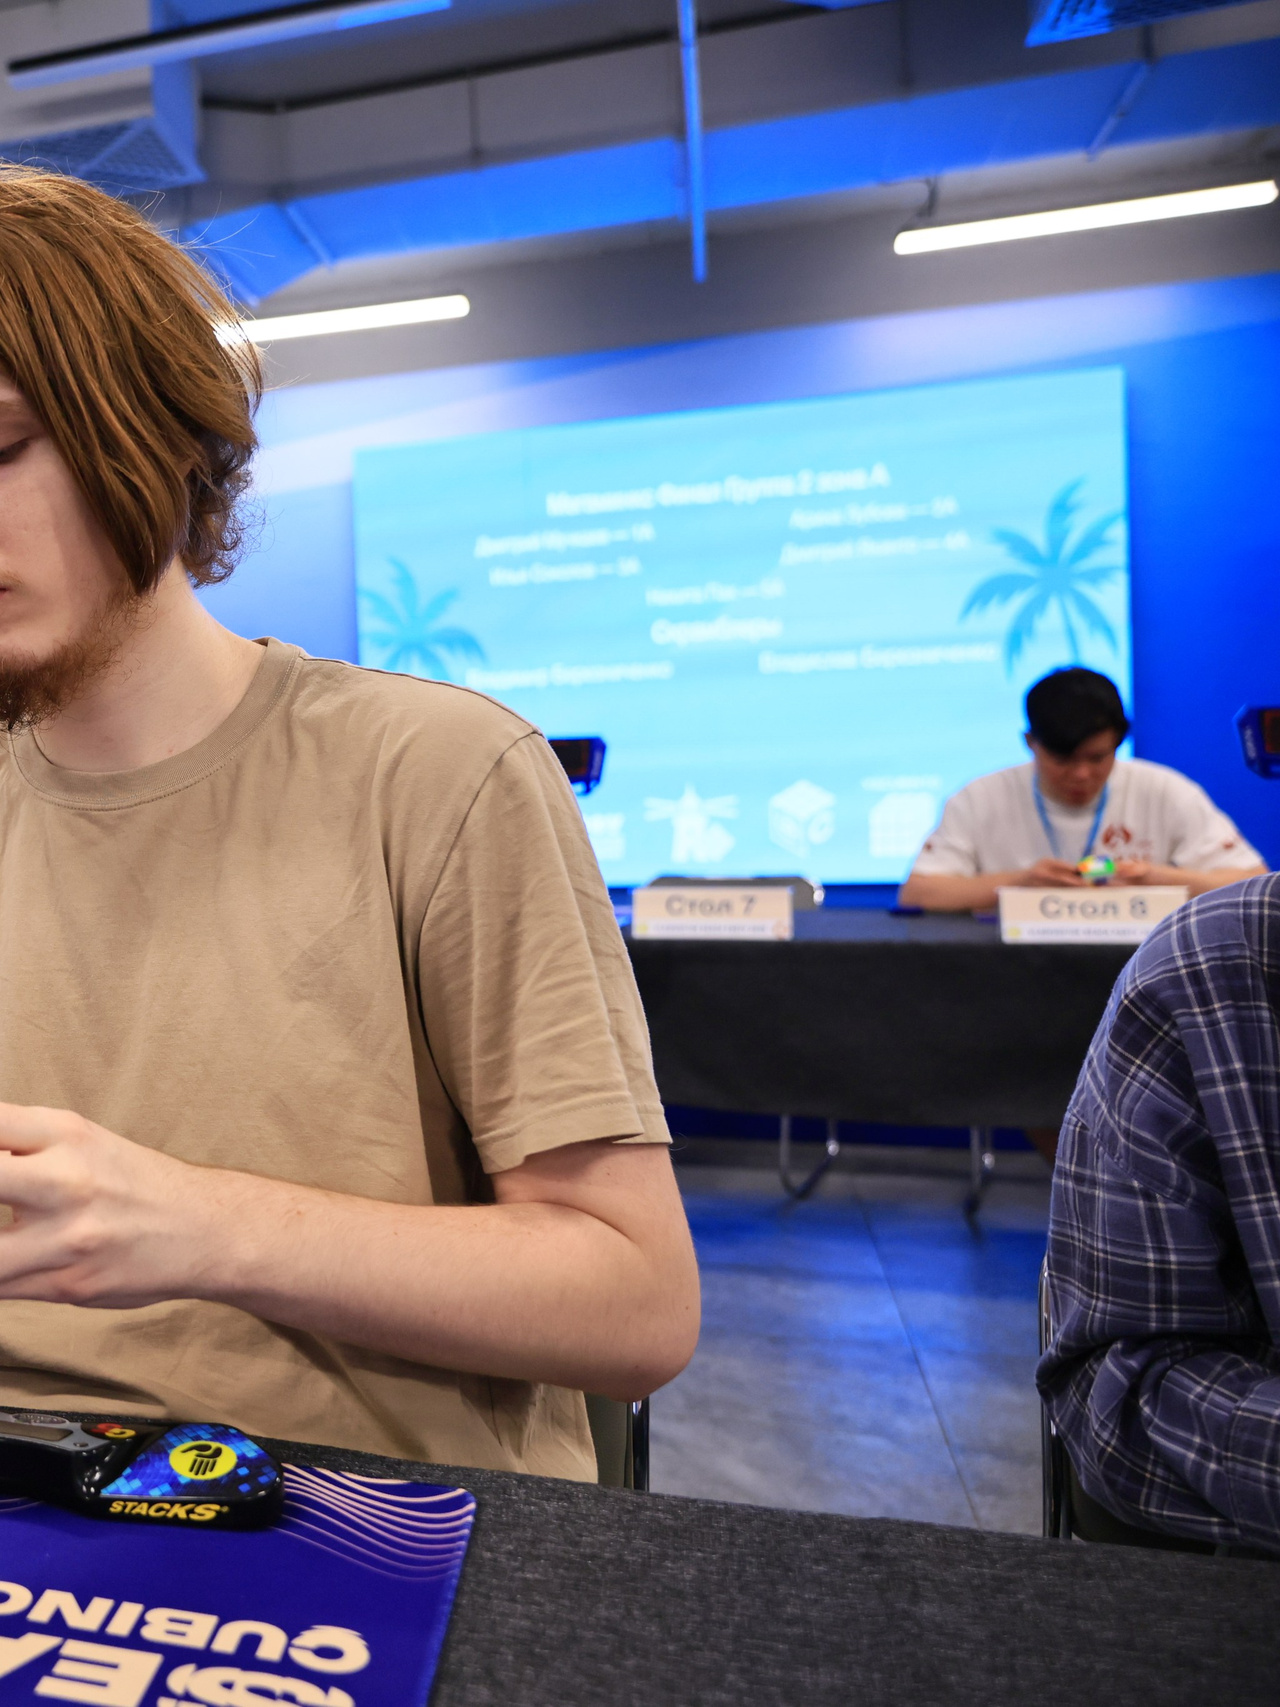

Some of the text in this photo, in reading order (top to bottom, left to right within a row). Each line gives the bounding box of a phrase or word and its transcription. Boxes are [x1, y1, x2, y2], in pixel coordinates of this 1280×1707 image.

[664, 895, 757, 918] Стол 7
[1038, 894, 1119, 919] Стол
[108, 1499, 220, 1521] STACKS
